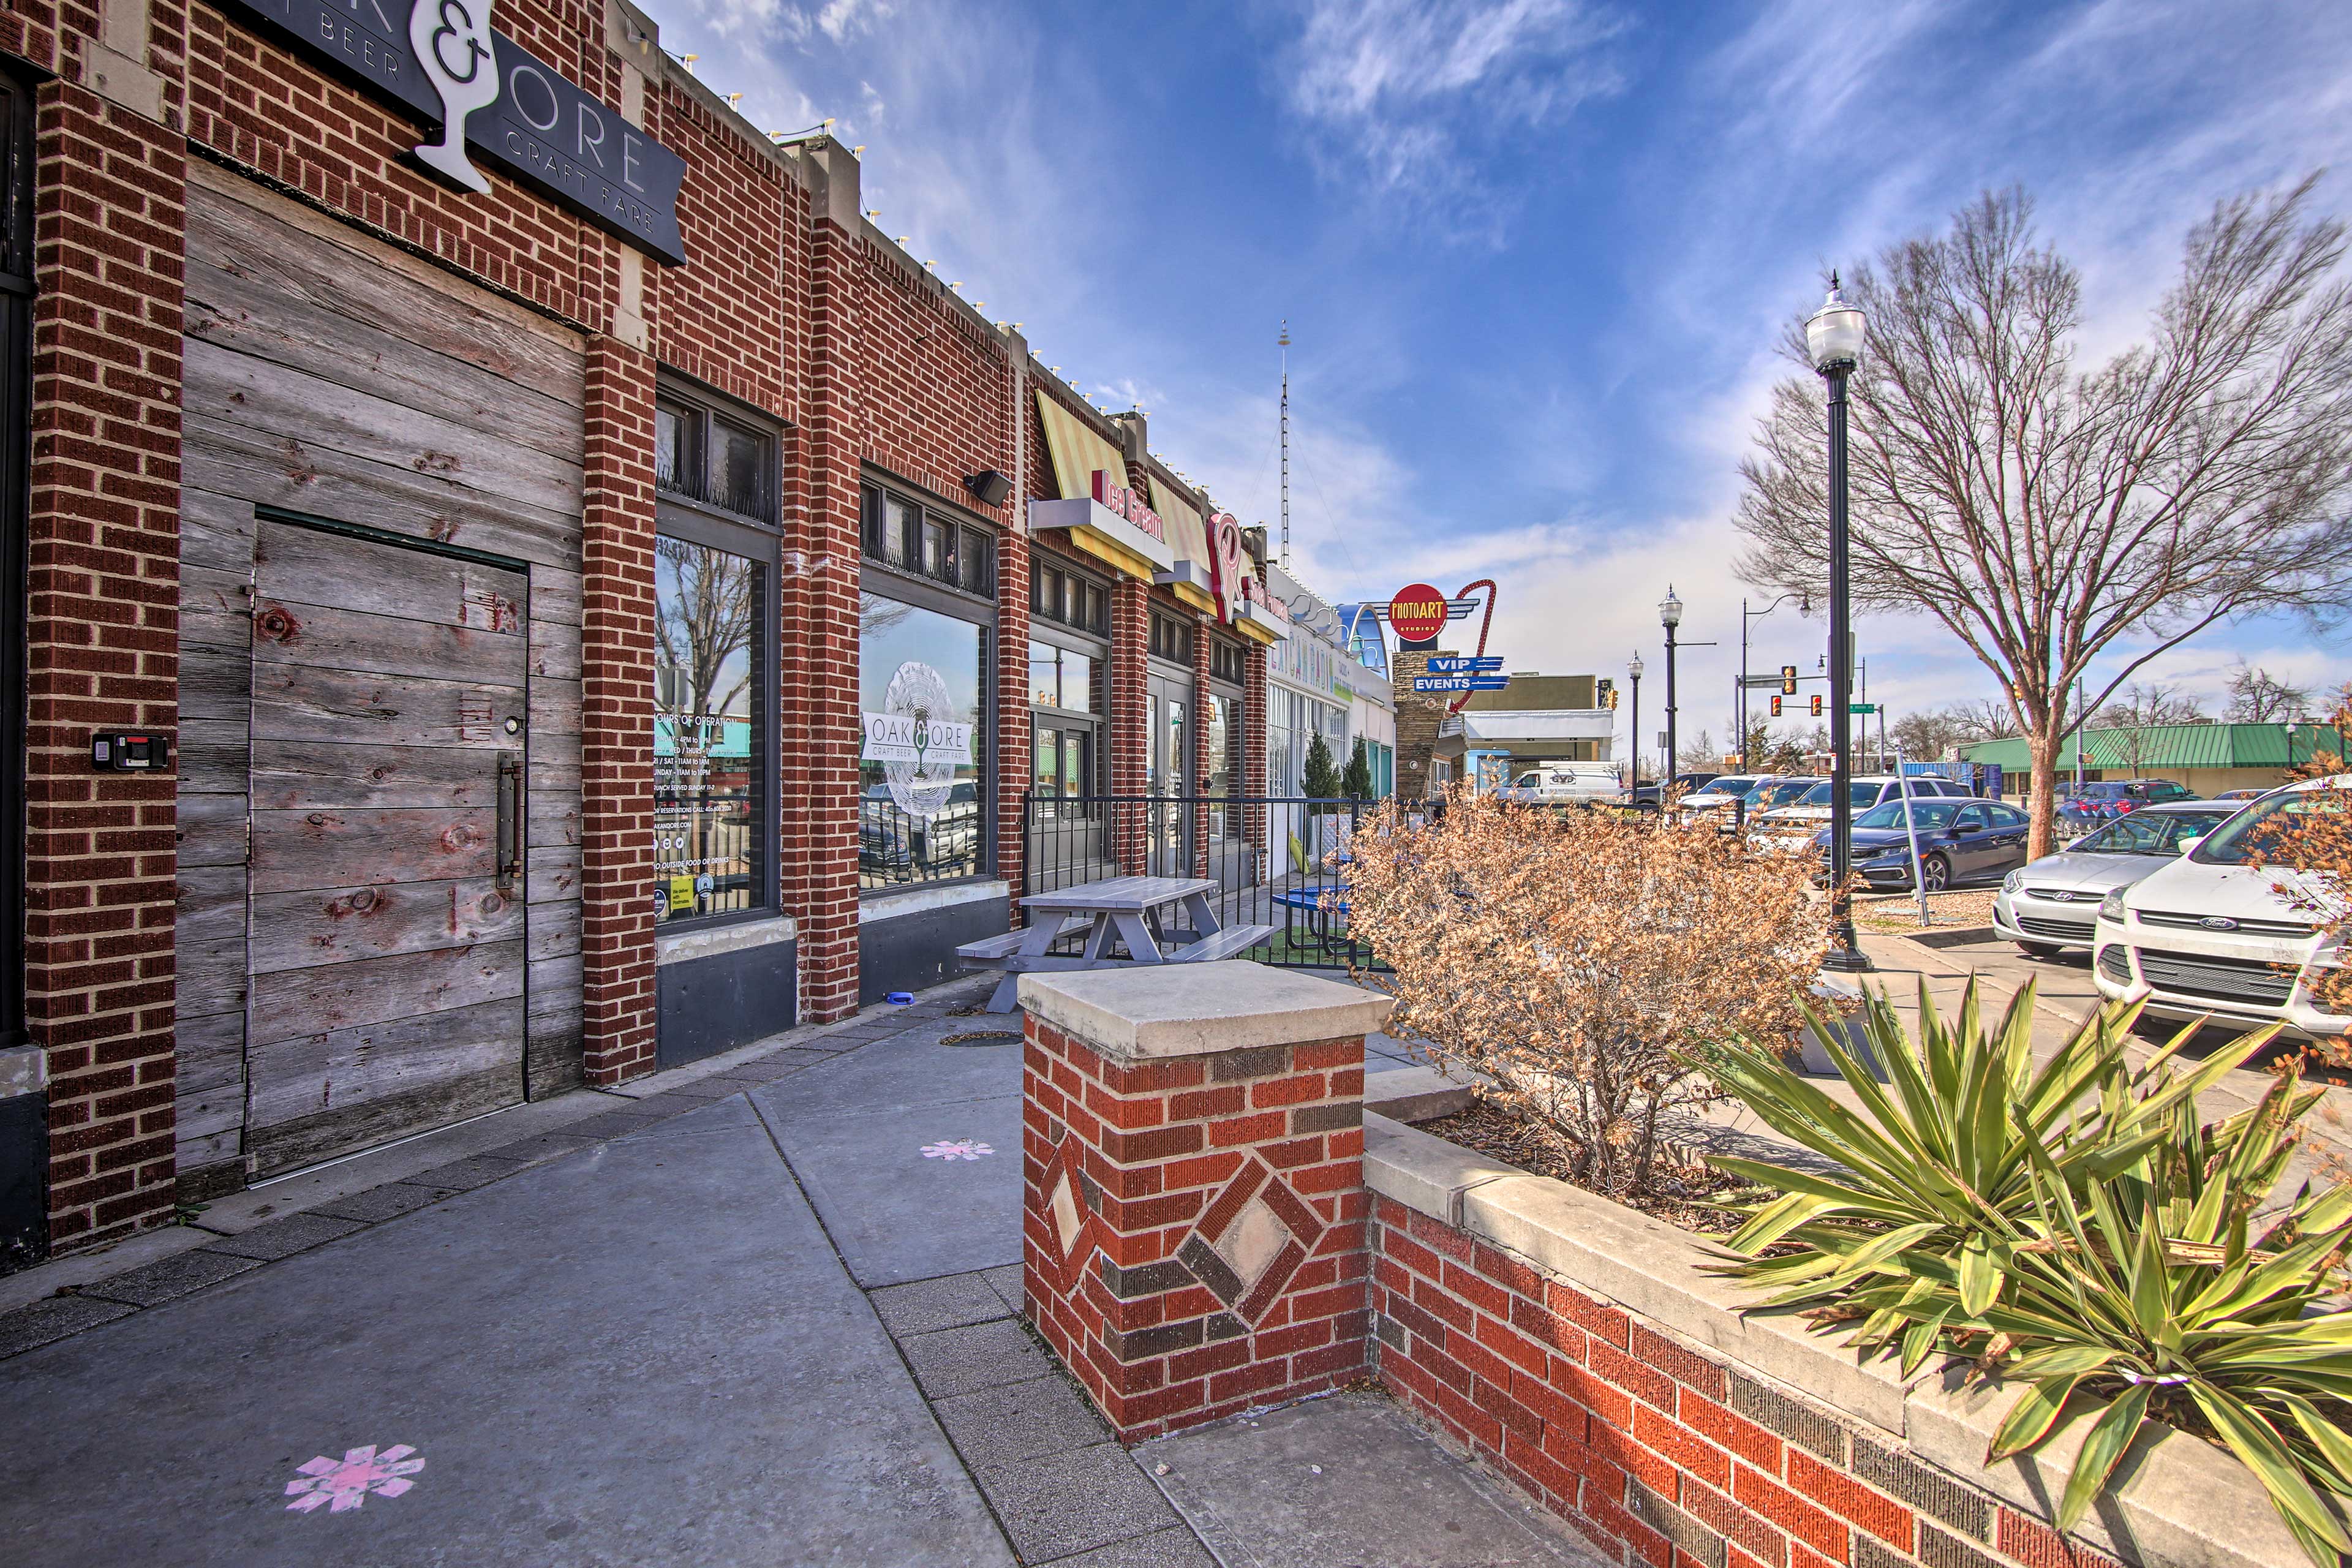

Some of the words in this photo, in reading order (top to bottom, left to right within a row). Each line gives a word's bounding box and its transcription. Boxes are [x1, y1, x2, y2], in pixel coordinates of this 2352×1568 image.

[322, 12, 398, 81] BEER
[432, 0, 489, 84] &
[510, 65, 644, 193] ORE
[507, 132, 588, 192] CRAFT
[603, 186, 652, 233] FARE
[1102, 469, 1125, 518] Ice
[1126, 487, 1165, 545] Cream
[1392, 601, 1443, 619] PHOTOART
[1436, 660, 1470, 670] VIP
[1416, 679, 1470, 689] EVENTS
[654, 713, 679, 724] OURS
[681, 715, 692, 725] OF
[695, 715, 737, 727] OPERATION
[873, 718, 910, 743] OAK
[932, 725, 962, 747] ORE
[873, 747, 894, 756] CRAFT
[897, 748, 911, 757] BEER
[931, 751, 949, 760] CRAFT
[951, 752, 965, 760] FARE
[662, 860, 685, 869] OUTSIDE
[2206, 918, 2227, 927] Ford
